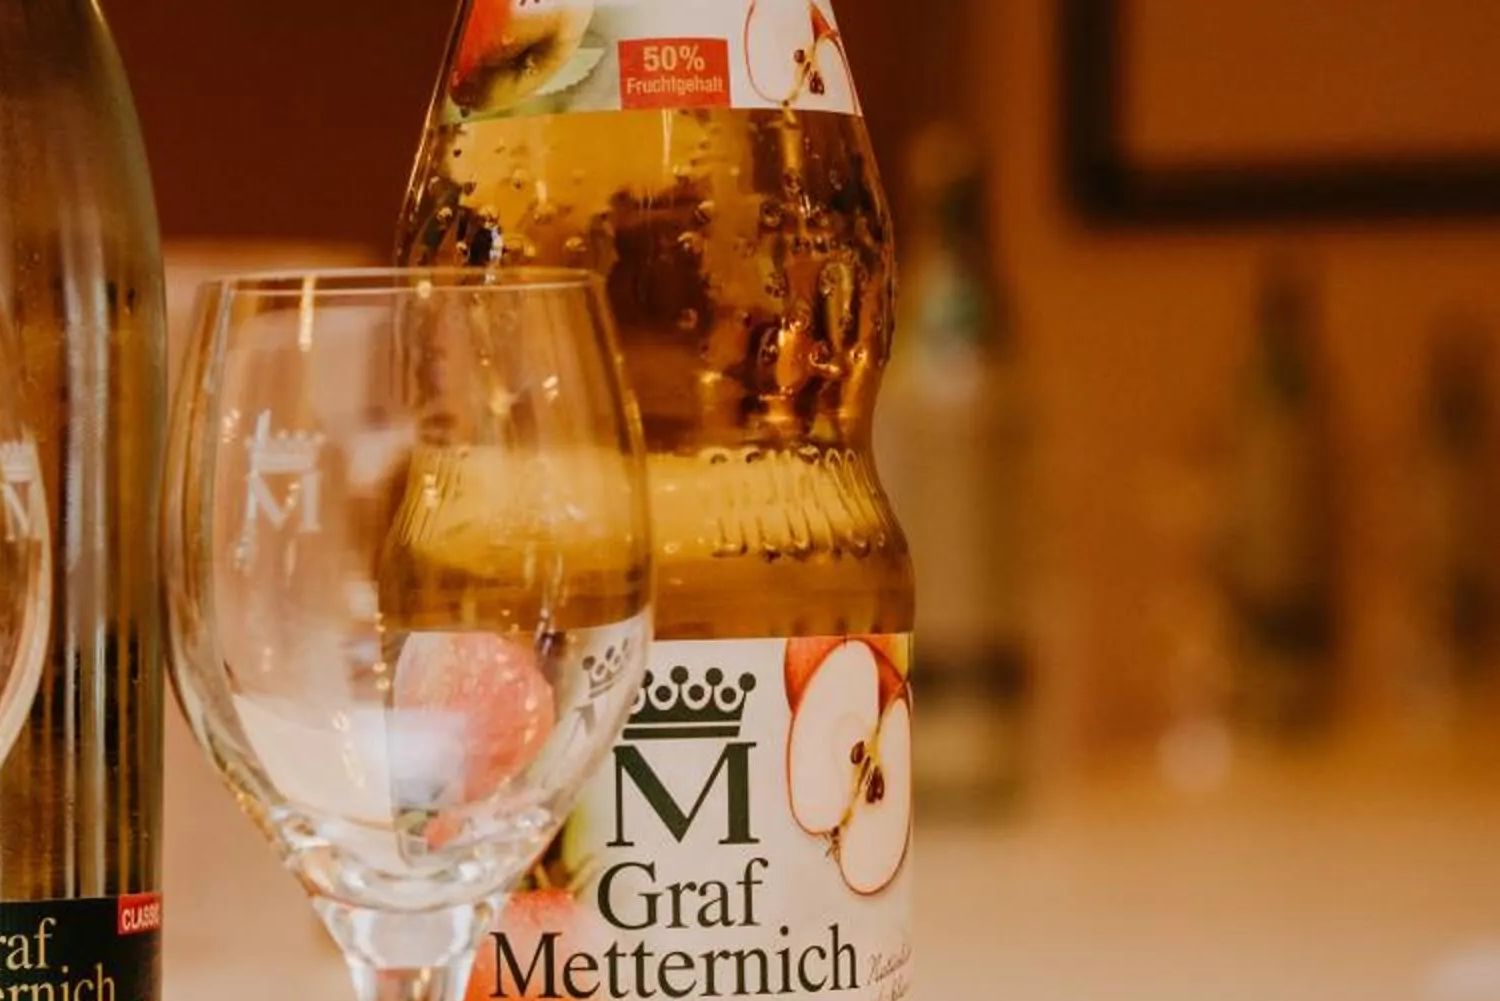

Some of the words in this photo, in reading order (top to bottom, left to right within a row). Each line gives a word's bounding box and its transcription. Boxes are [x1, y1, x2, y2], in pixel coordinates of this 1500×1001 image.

[626, 76, 724, 96] Fruchtgehalt
[643, 45, 705, 73] 50%
[606, 741, 759, 848] M
[598, 858, 769, 931] Graf
[489, 923, 860, 999] Metternich
